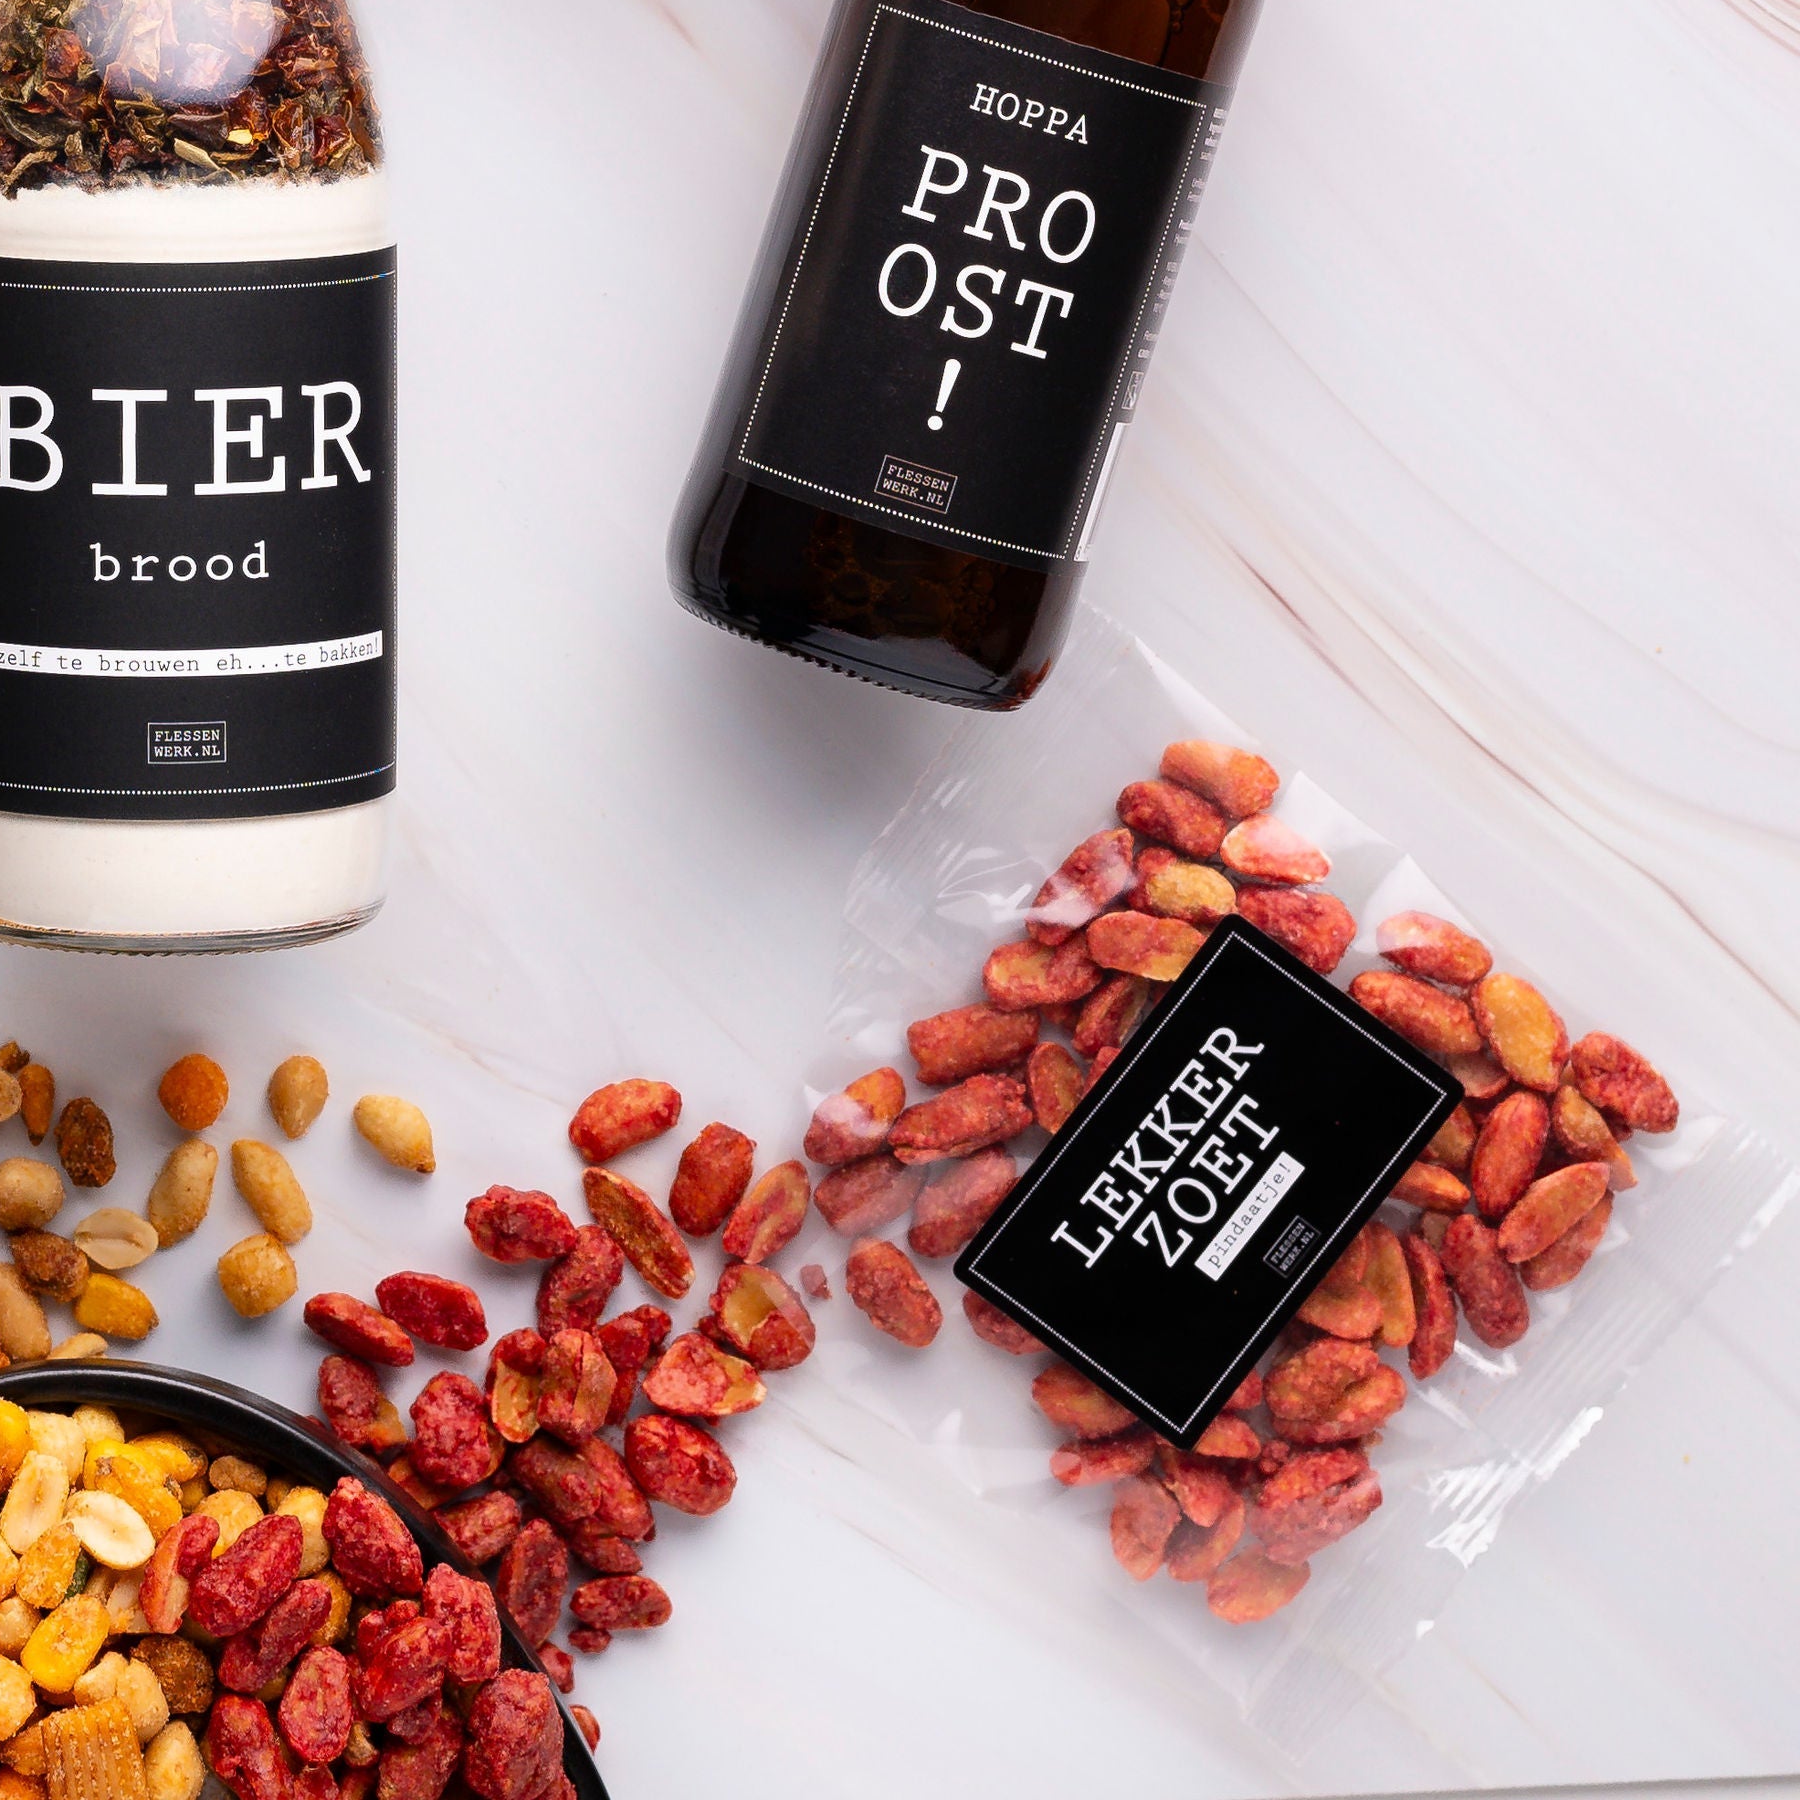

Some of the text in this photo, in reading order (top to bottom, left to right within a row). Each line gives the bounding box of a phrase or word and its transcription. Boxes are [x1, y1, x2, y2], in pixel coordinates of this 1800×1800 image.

[969, 83, 1089, 145] HOPPA
[901, 144, 1096, 264] PRO
[877, 243, 1075, 360] OST
[926, 358, 962, 431] !
[882, 478, 944, 507] WERK.NL
[887, 464, 950, 492] FLESSEN
[89, 540, 270, 582] brood
[56, 653, 83, 671] te
[98, 653, 200, 673] brouwen
[319, 637, 381, 664] bakken!
[153, 744, 221, 758] WERK.NL
[154, 729, 220, 742] FLESSEN
[1050, 1027, 1265, 1269] LEKKER
[1132, 1094, 1281, 1268] ZOET
[1206, 1160, 1292, 1270] pindaatje!
